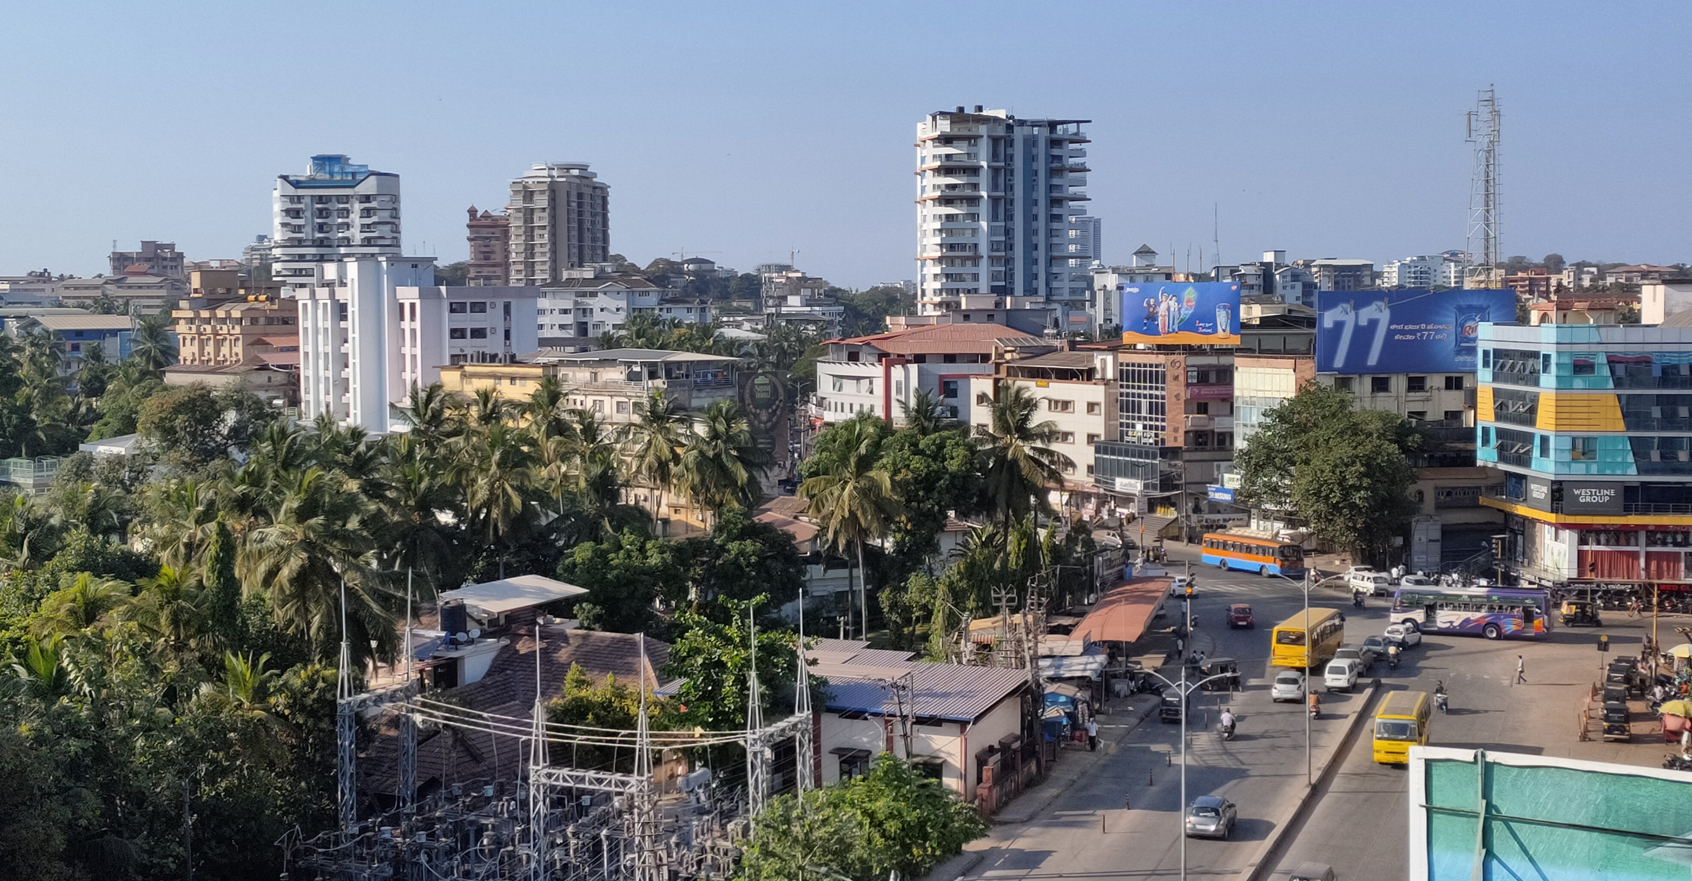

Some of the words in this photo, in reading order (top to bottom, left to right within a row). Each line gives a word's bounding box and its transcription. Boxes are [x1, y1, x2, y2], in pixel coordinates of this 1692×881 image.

[1324, 302, 1390, 368] 77
[1573, 488, 1616, 496] WESTLINE
[1579, 495, 1610, 503] GROUP
